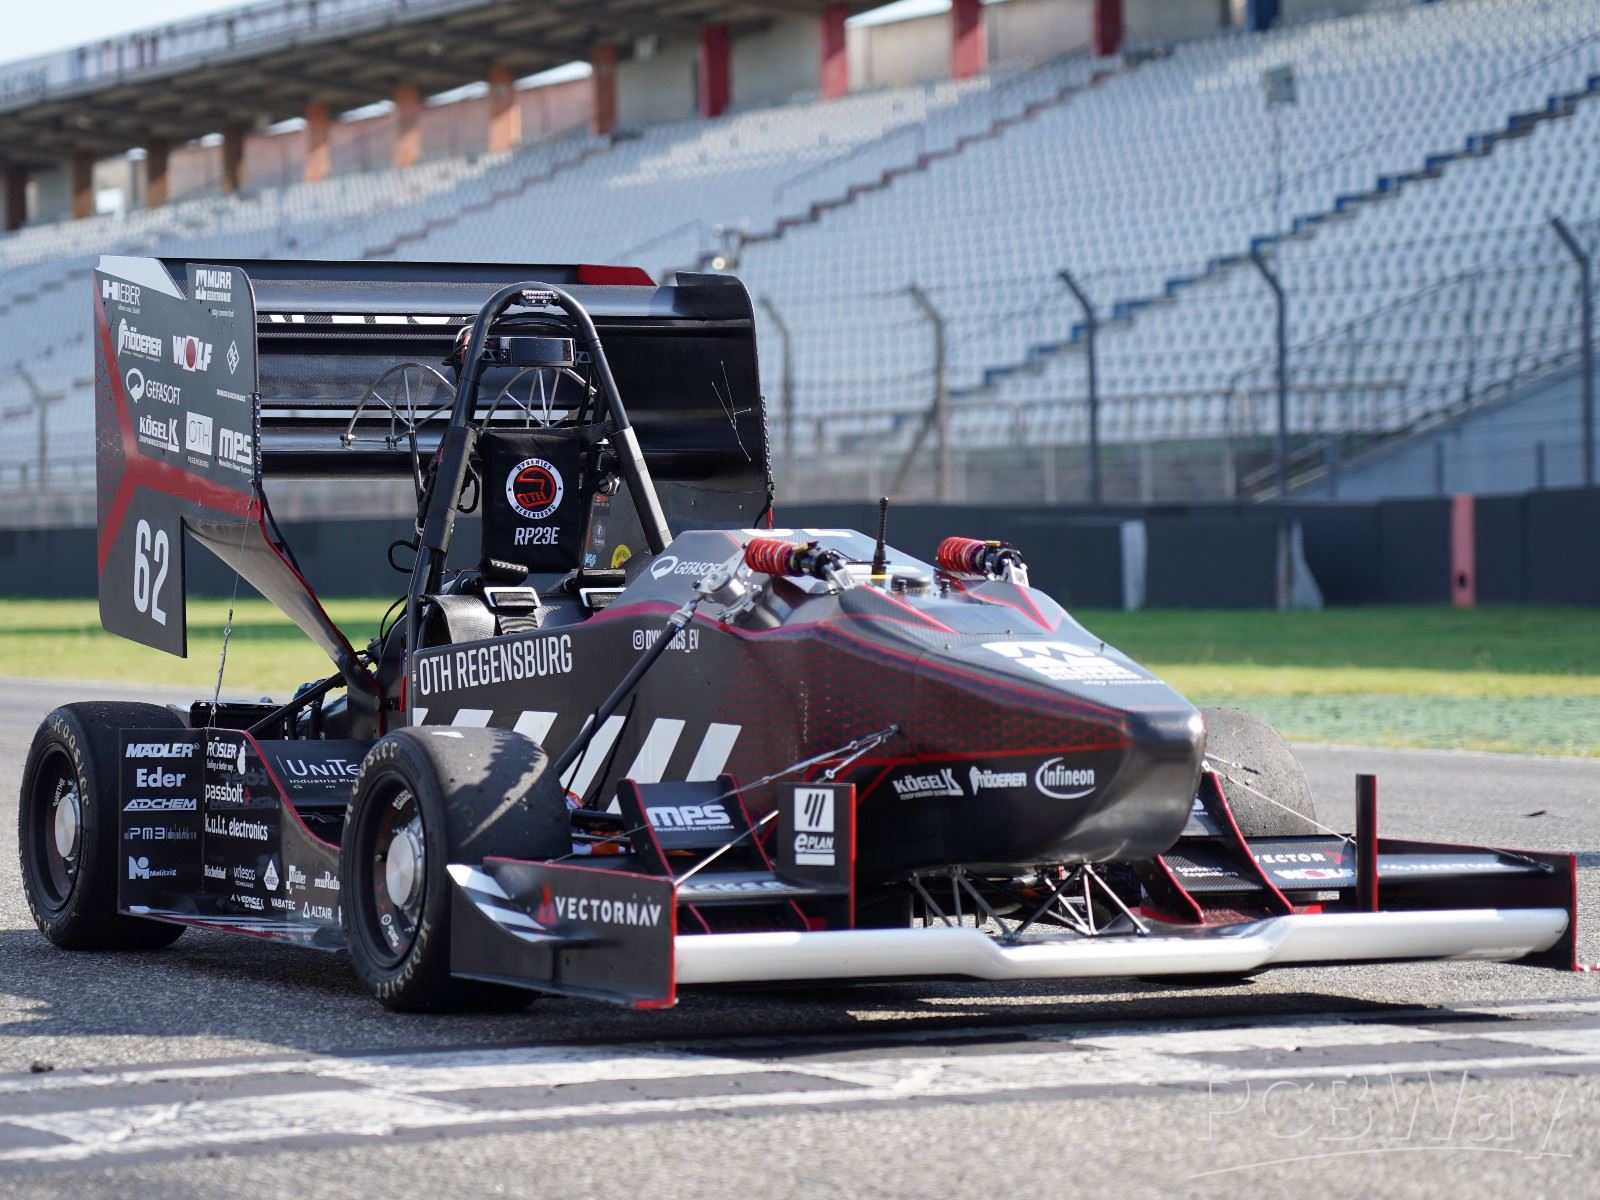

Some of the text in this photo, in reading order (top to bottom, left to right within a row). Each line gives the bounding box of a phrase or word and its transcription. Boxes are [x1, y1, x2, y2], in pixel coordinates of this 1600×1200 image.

[207, 272, 231, 290] MURR
[173, 335, 213, 371] WOLF
[146, 379, 181, 406] GEFASOFT
[139, 415, 168, 440] KÖGEL
[514, 527, 560, 545] RP23E
[133, 519, 169, 626] 62
[419, 634, 573, 696] OTH REGENSBURG
[207, 737, 237, 760] RÖSLER
[136, 767, 186, 787] Eder
[893, 775, 946, 793] KÖGEL
[1044, 765, 1095, 786] Infineon
[205, 782, 243, 803] passbolt
[123, 799, 197, 811] ADCHEM
[205, 813, 227, 835] k.u.l.t.
[229, 817, 268, 841] electronics
[311, 905, 332, 919] ALTAIR
[555, 896, 661, 927] VECTORNAV
